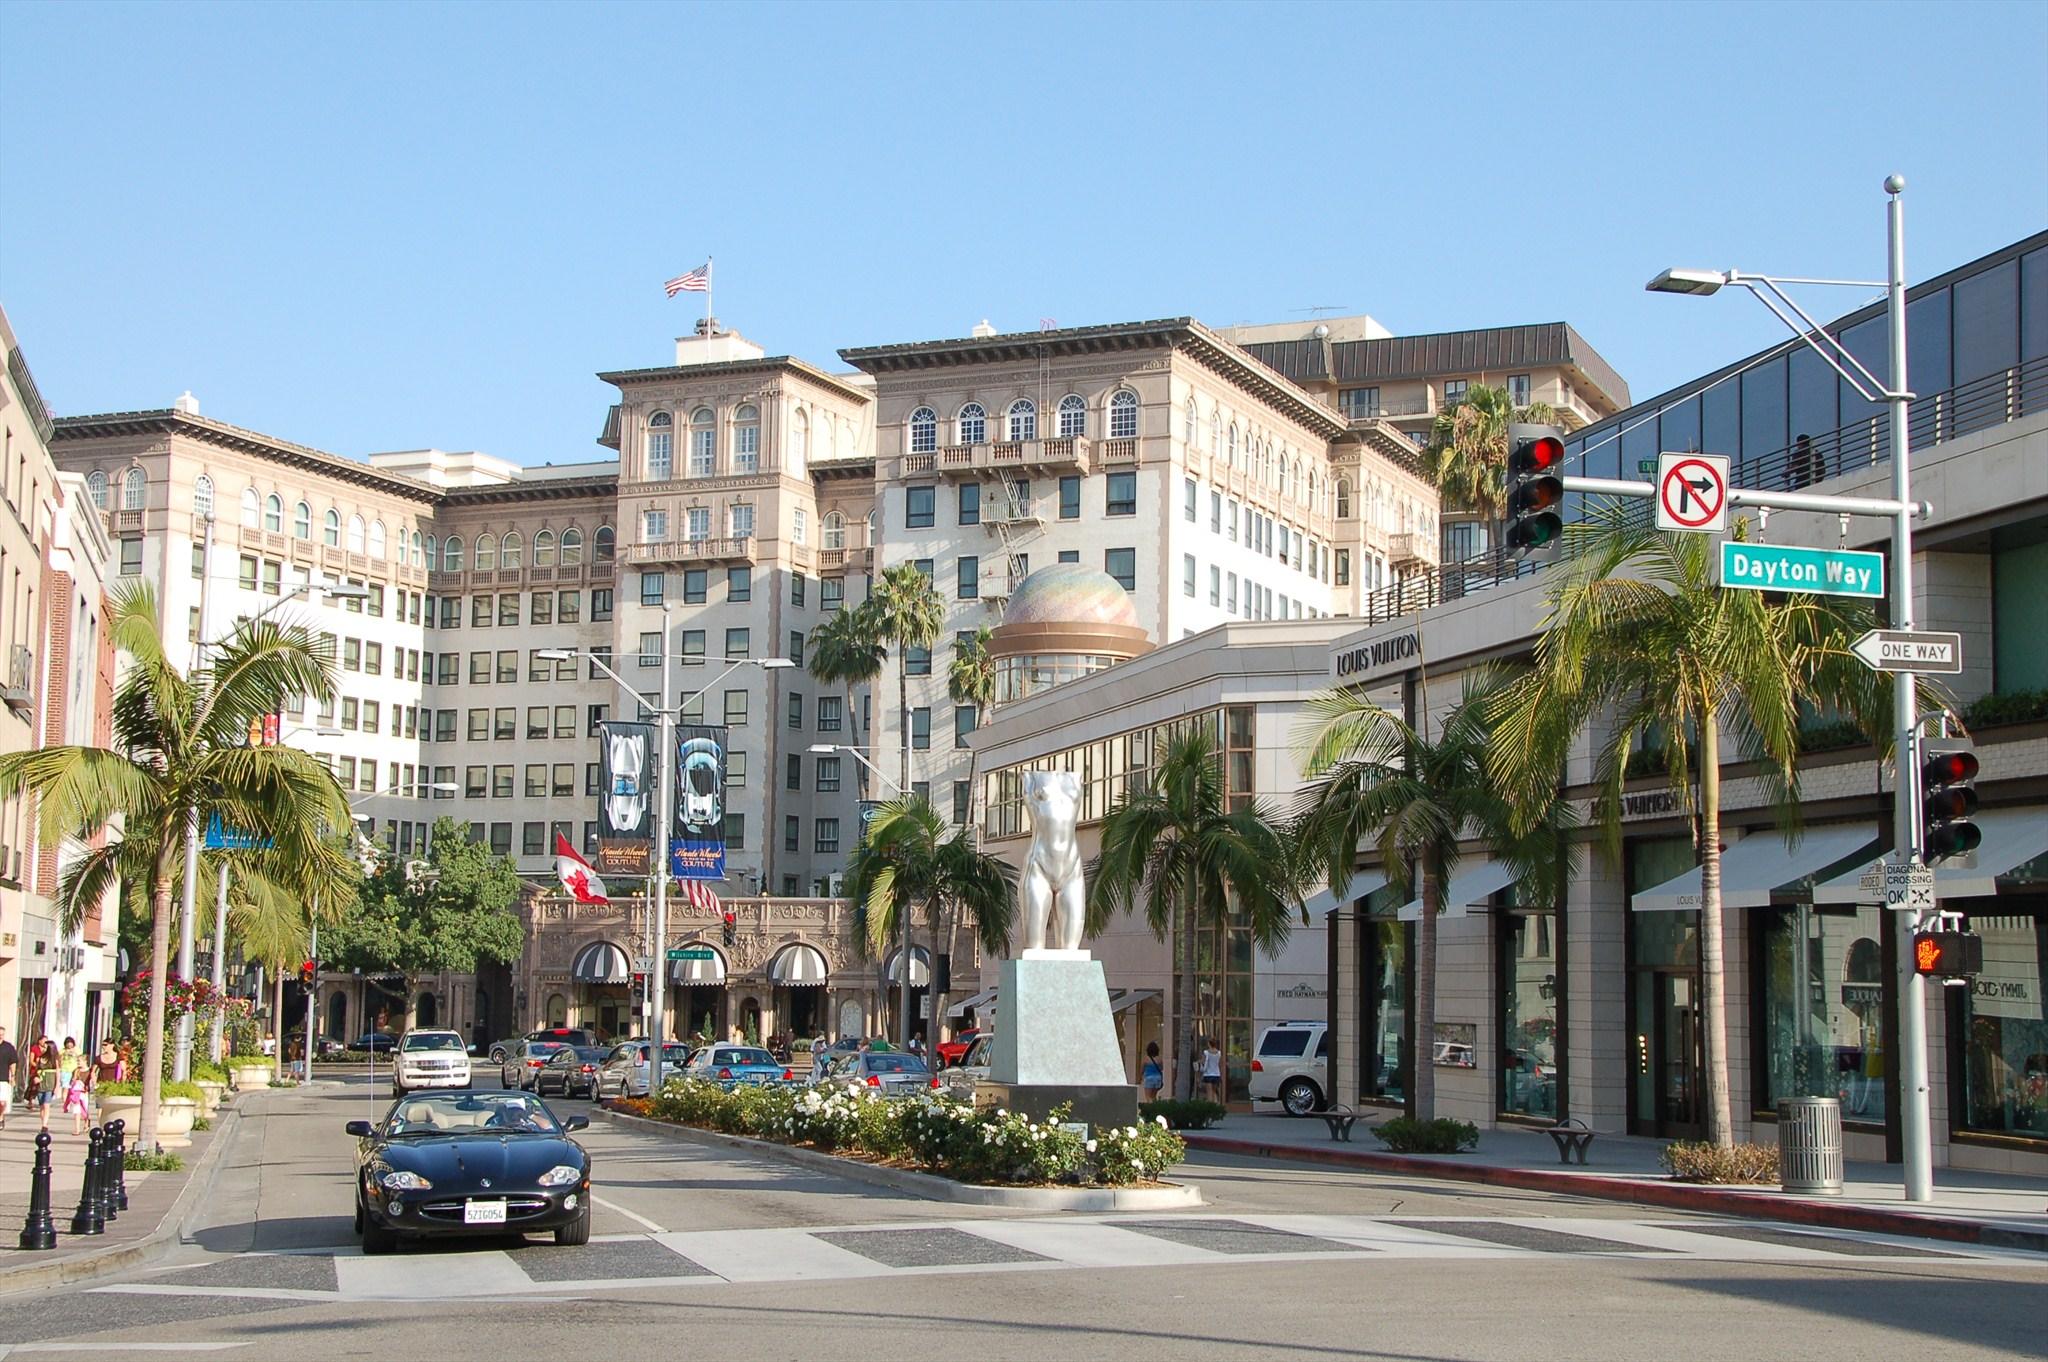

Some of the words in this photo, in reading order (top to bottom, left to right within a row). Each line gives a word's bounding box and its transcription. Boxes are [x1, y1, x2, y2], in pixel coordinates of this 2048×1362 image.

[1733, 553, 1818, 584] Dayton
[1825, 560, 1872, 591] Way
[1337, 648, 1369, 676] LOUIS
[1371, 631, 1420, 665] VUITTON
[1882, 643, 1912, 658] ONE
[1916, 645, 1947, 660] WAY
[606, 858, 640, 867] COUTURE
[681, 860, 715, 869] COUTURE
[1887, 865, 1931, 875] DIAGONAL
[1860, 876, 1880, 888] RODEO
[1887, 875, 1932, 885] CROSSING
[1676, 895, 1695, 905] LOUIS
[1888, 890, 1905, 905] OK
